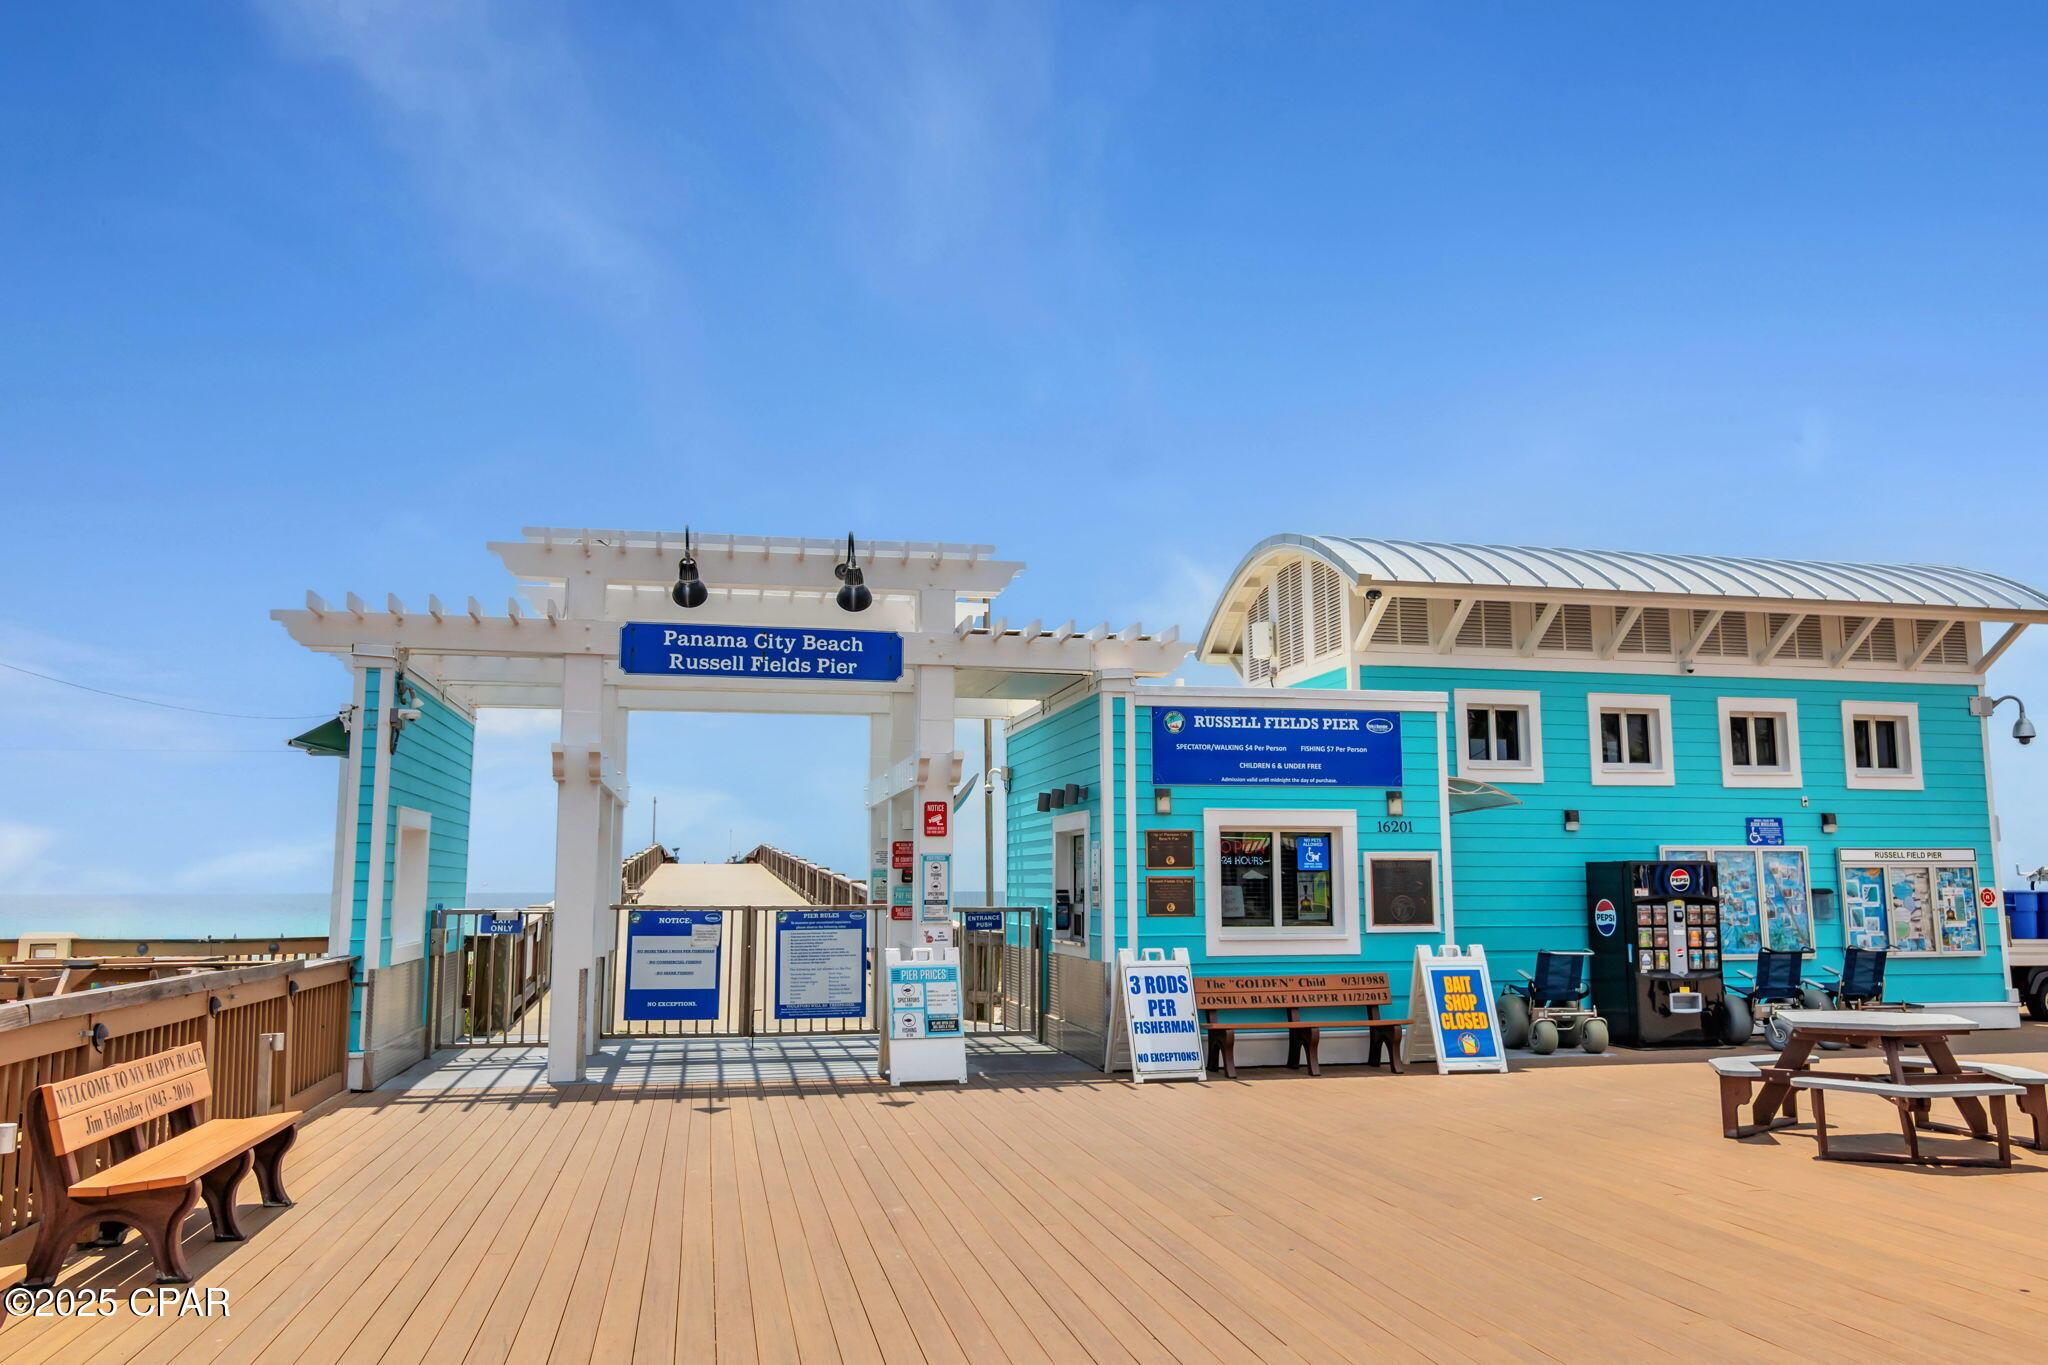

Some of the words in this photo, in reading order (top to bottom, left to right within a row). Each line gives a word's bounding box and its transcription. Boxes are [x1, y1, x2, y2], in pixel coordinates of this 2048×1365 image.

[664, 630, 748, 649] Panama
[754, 634, 796, 654] City
[802, 635, 863, 652] Beach
[669, 654, 744, 671] Russell
[751, 656, 810, 672] Fields
[817, 658, 857, 674] Pier
[1194, 716, 1260, 728] RUSSELL
[1264, 717, 1319, 729] FIELDS
[1322, 718, 1359, 730] PIER
[1378, 821, 1412, 832] 16201
[1235, 856, 1264, 865] HOURS
[902, 970, 917, 980] PIER
[921, 969, 946, 980] PRICES
[1341, 976, 1385, 986] 9/3/1988
[1129, 976, 1141, 994] 3
[1144, 975, 1189, 994] RODS
[1205, 980, 1226, 989] The
[1229, 978, 1294, 988] "GOLDEN"
[1298, 978, 1326, 987] Child
[1443, 976, 1472, 993] BAIT
[1200, 996, 1248, 1005] JOSHUA
[1251, 995, 1287, 1004] BLAKE
[1291, 993, 1339, 1003] HARPER
[1342, 992, 1388, 1002] 11/2/2013
[1444, 994, 1477, 1012] SHOP
[1148, 999, 1176, 1017] PER
[1134, 1020, 1195, 1034] FISHERMAN
[1441, 1012, 1488, 1030] CLOSED
[1138, 1053, 1149, 1062] NO
[1151, 1052, 1200, 1062] EXCEPTIONS!
[56, 1074, 111, 1108] WELCOME
[111, 1070, 128, 1090] TO
[128, 1066, 148, 1086] MY
[147, 1056, 176, 1078] HAPPY
[176, 1048, 203, 1069] PLACE
[86, 1116, 103, 1136] Jim
[104, 1101, 144, 1128] Holladay
[145, 1090, 166, 1116] (1943
[173, 1081, 195, 1103] 2016)
